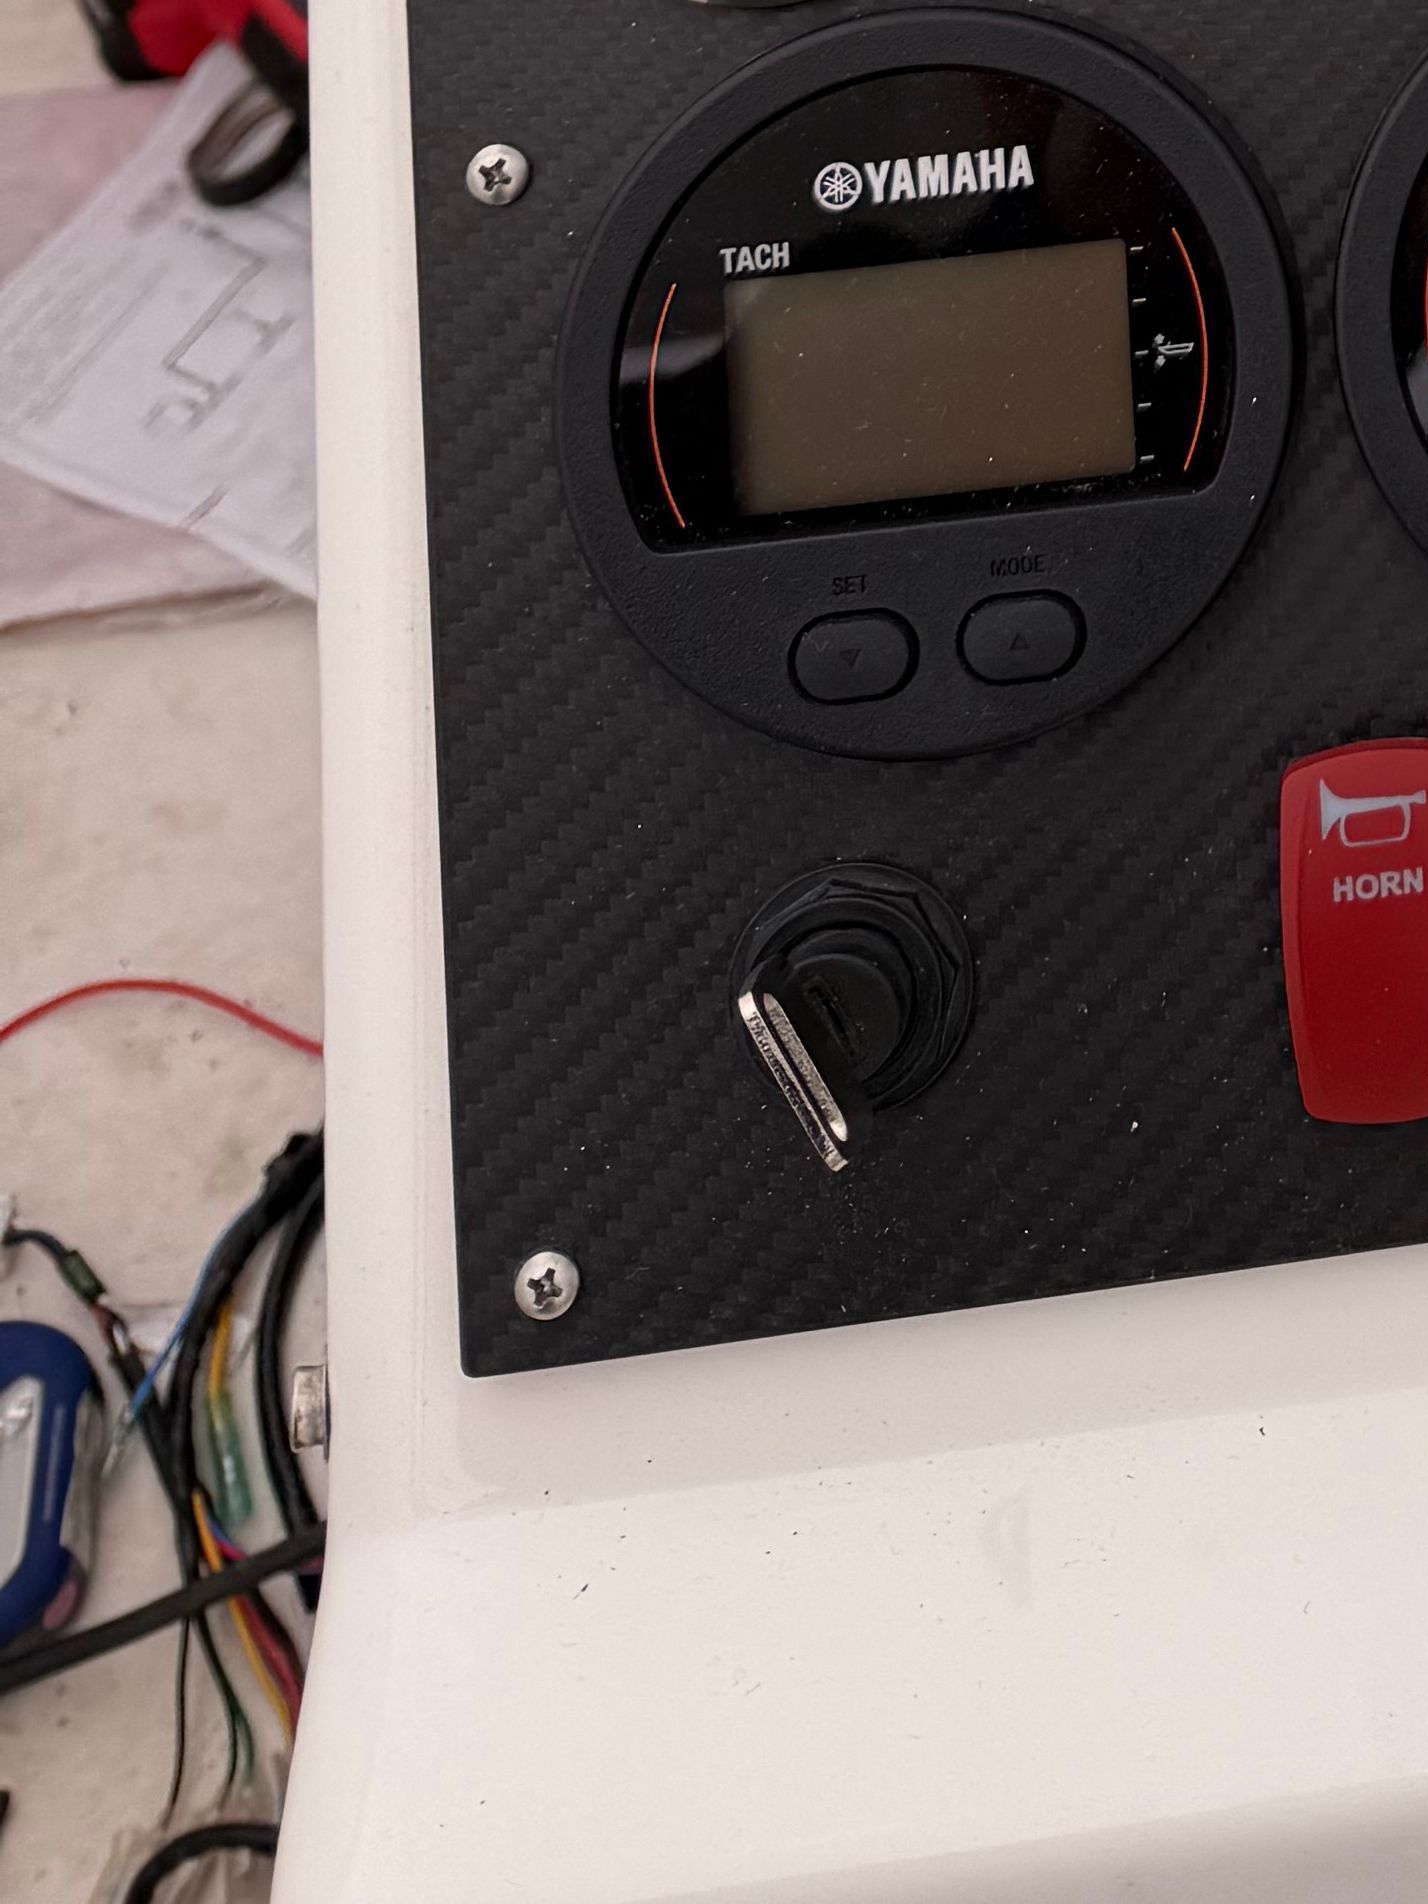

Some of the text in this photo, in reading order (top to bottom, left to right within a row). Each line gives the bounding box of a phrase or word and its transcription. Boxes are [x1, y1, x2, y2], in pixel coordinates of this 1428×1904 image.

[863, 143, 1035, 205] YAMAHA
[720, 242, 790, 275] TACH
[990, 555, 1046, 577] MODE
[832, 575, 867, 596] SET
[1332, 868, 1425, 903] HORN
